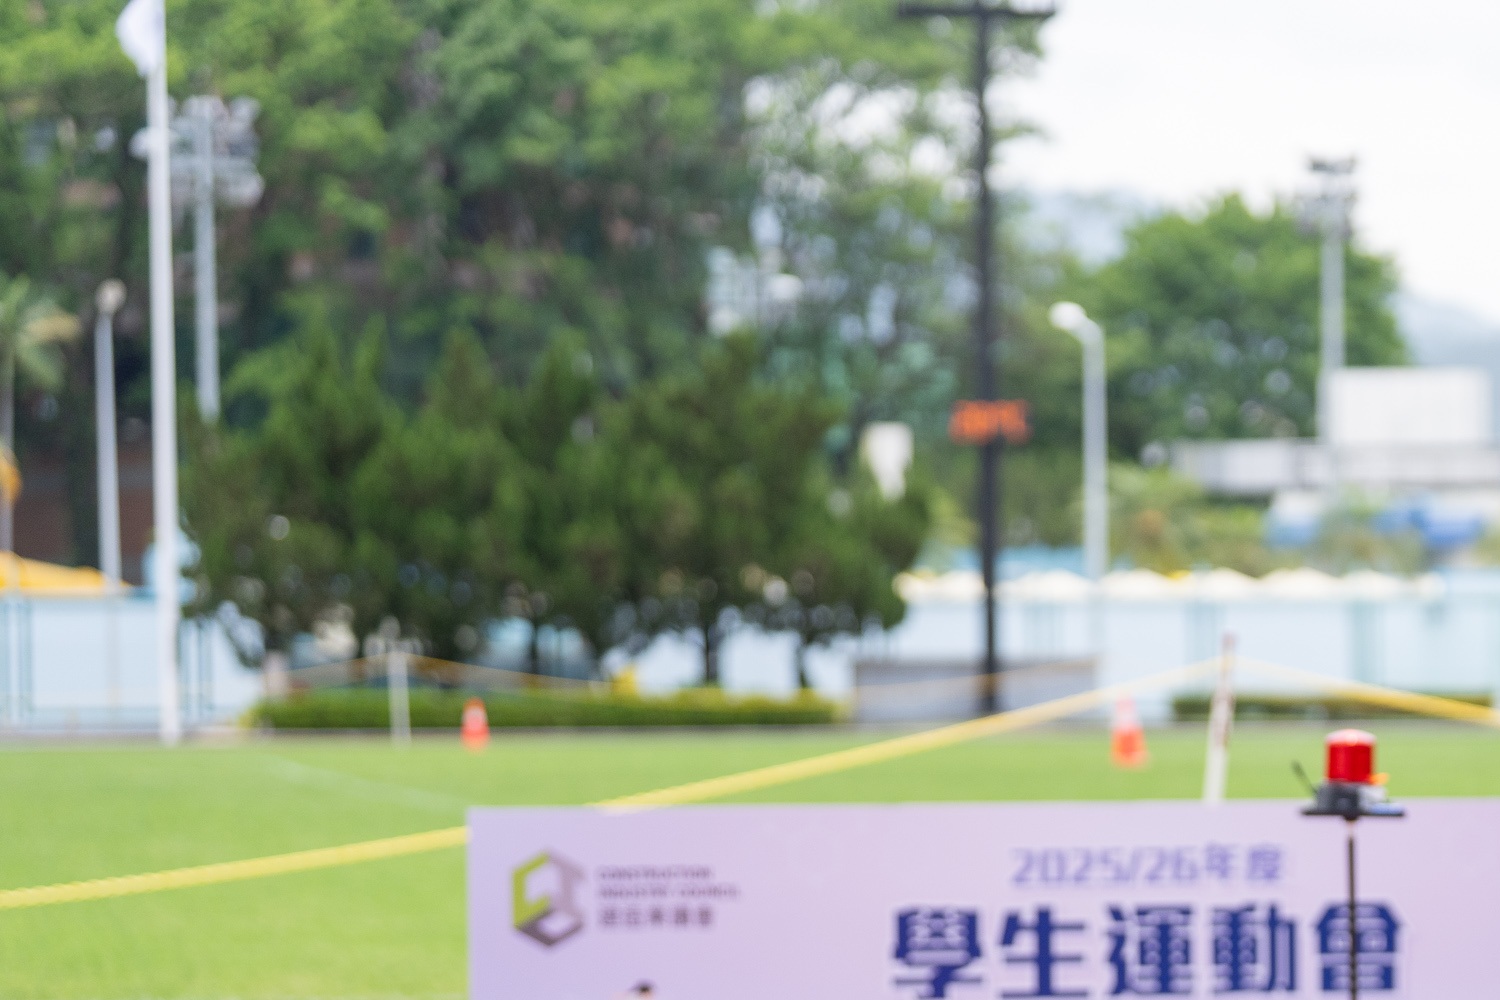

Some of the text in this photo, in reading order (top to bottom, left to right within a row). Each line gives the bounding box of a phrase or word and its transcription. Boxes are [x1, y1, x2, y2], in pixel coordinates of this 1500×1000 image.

[1009, 844, 1284, 886] 2025/26年度
[893, 899, 1402, 1000] 學生運動會
